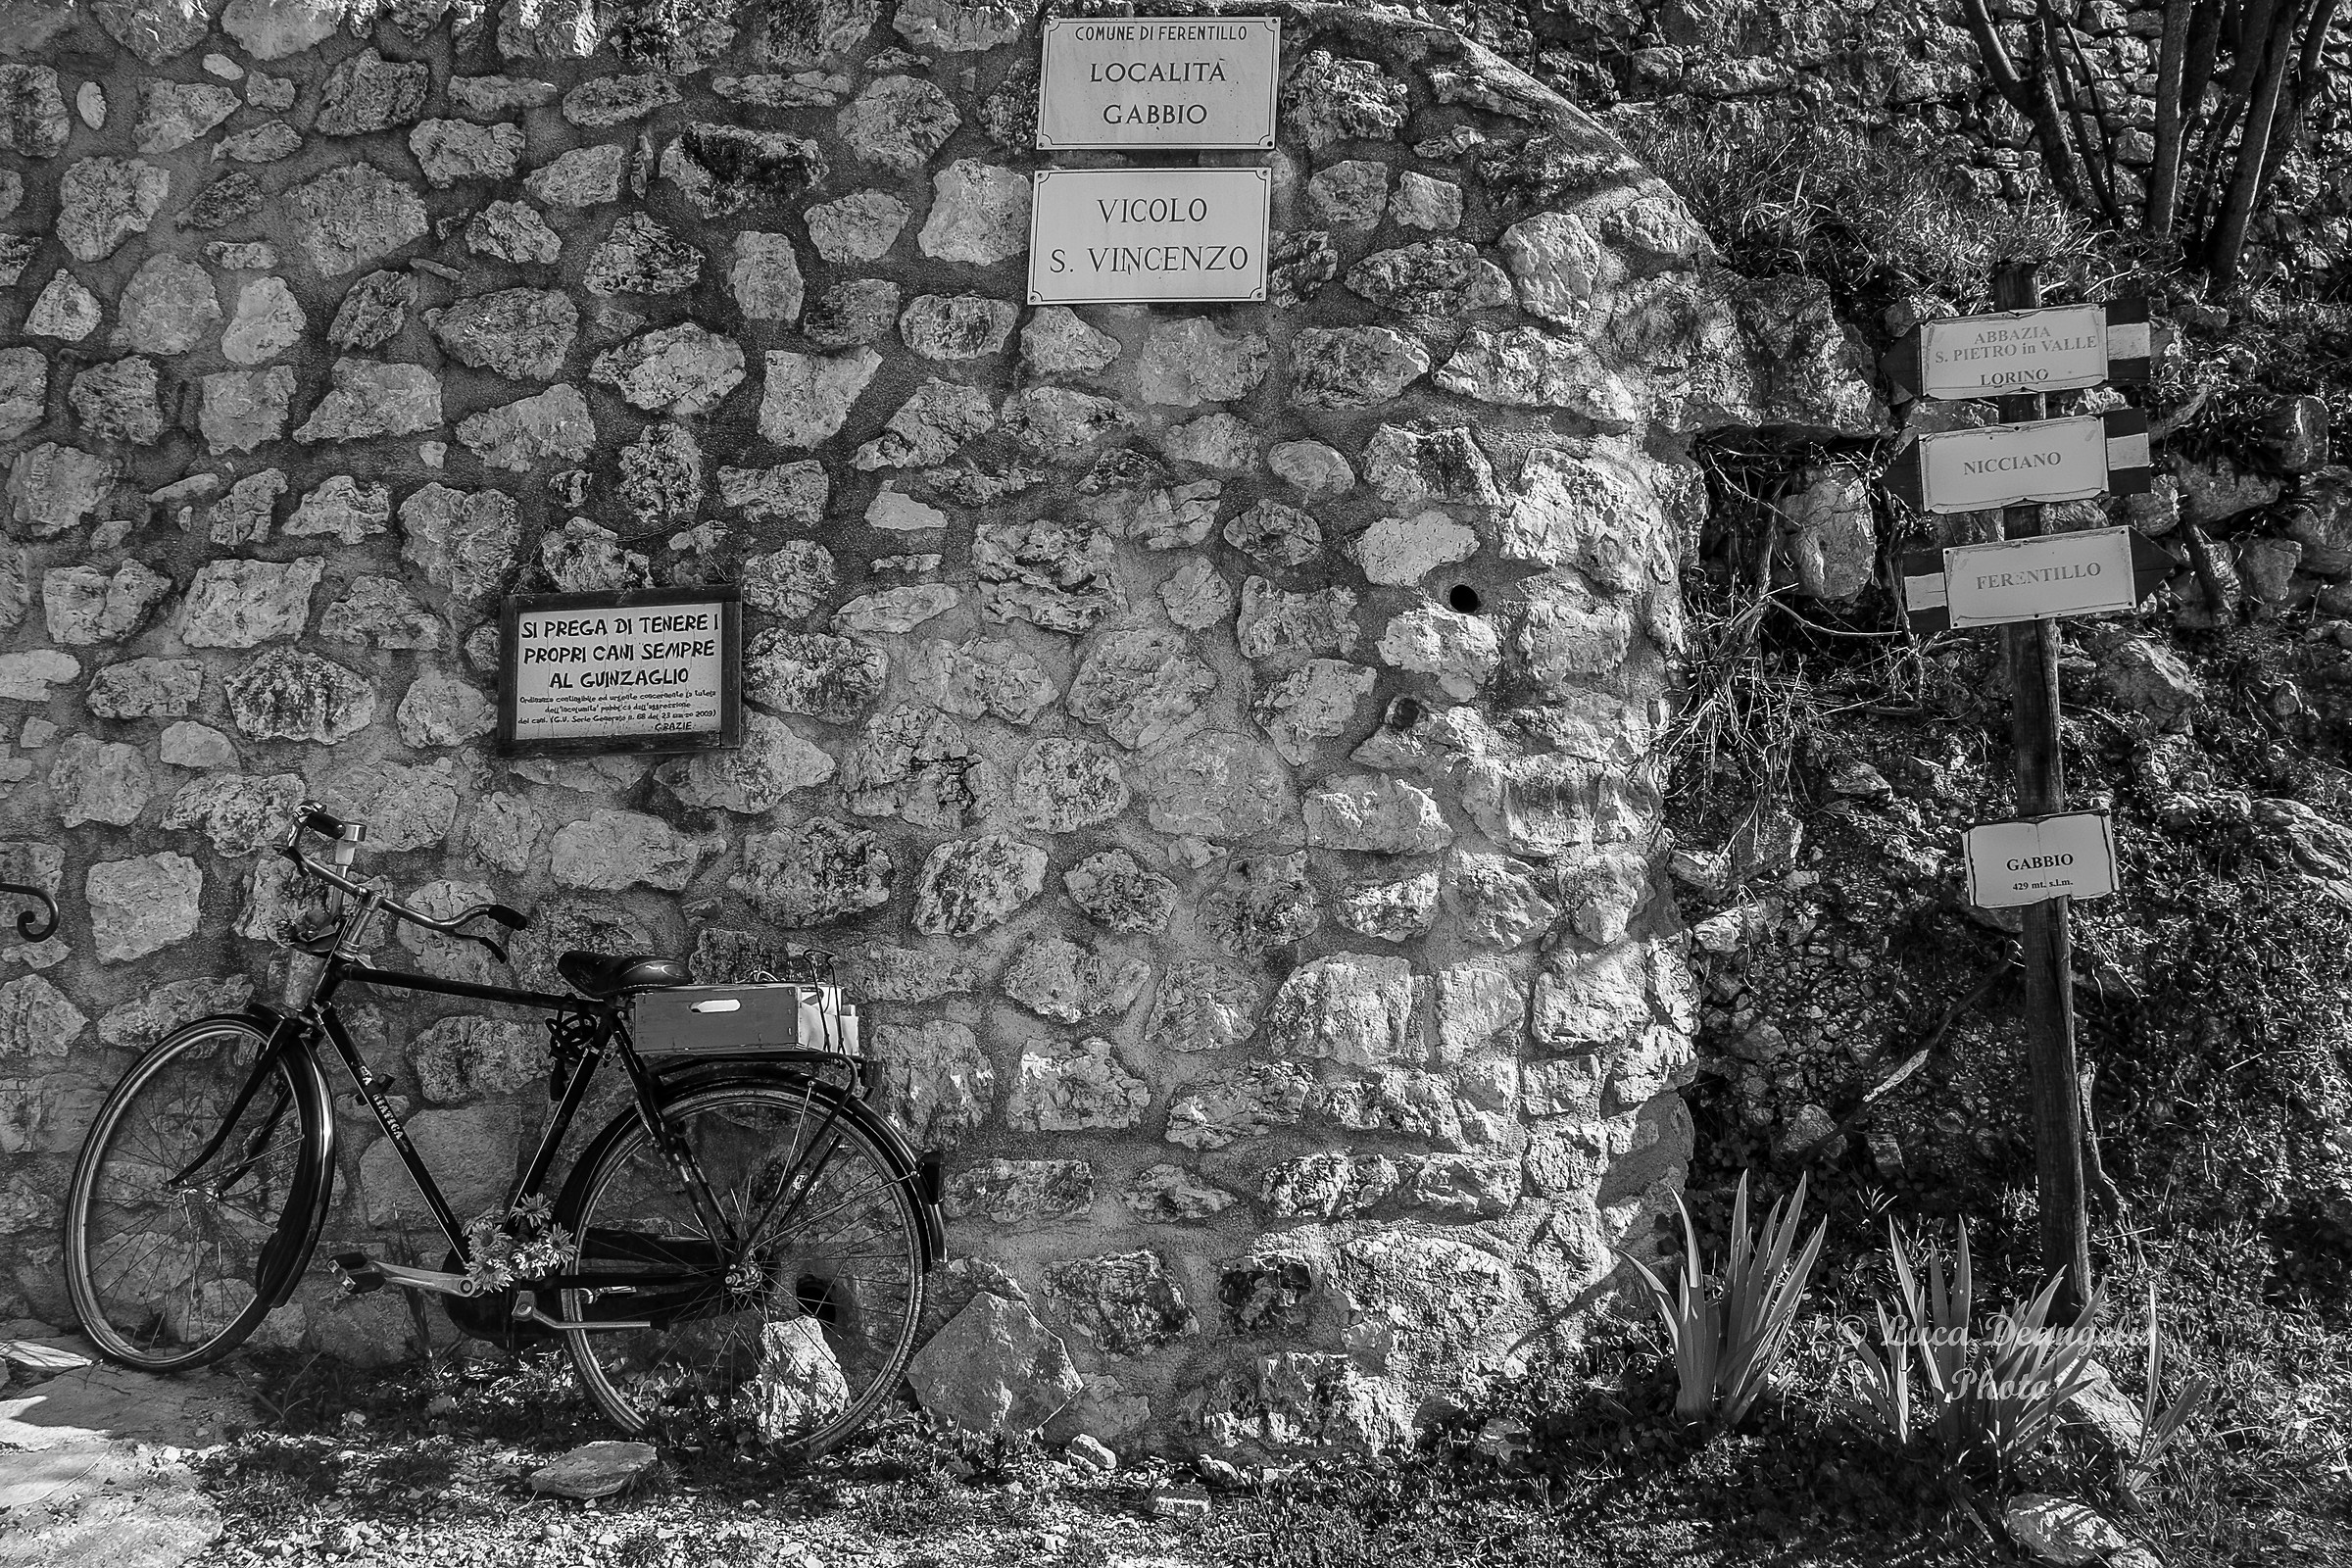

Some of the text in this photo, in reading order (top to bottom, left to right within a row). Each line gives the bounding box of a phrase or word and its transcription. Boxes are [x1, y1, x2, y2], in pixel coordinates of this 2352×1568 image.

[1075, 25, 1248, 41] COMUNE DI FERENTILLO
[1103, 105, 1207, 124] GABBIO
[1098, 198, 1207, 222] VICOLO
[1050, 246, 1249, 272] S. VINCENZO
[1974, 325, 2051, 345] ABBAZIA
[1935, 335, 2097, 364] S. PIETRO in VALLE
[1980, 368, 2049, 387] LORINO
[1963, 452, 2062, 476] NICCIANO
[1976, 563, 2101, 590] FERENTILLO
[521, 613, 718, 638] SI PREGA DI TENERE I
[524, 640, 715, 664] PROPRI CANI SEMPRE
[550, 667, 689, 689] AL GUINZAGLIO
[598, 693, 608, 702] ed
[610, 692, 638, 704] urgente
[655, 721, 693, 731] GRAZIE
[2007, 854, 2074, 871] GABBIO
[2032, 881, 2046, 890] mt.
[2048, 879, 2074, 888] s.l.m.
